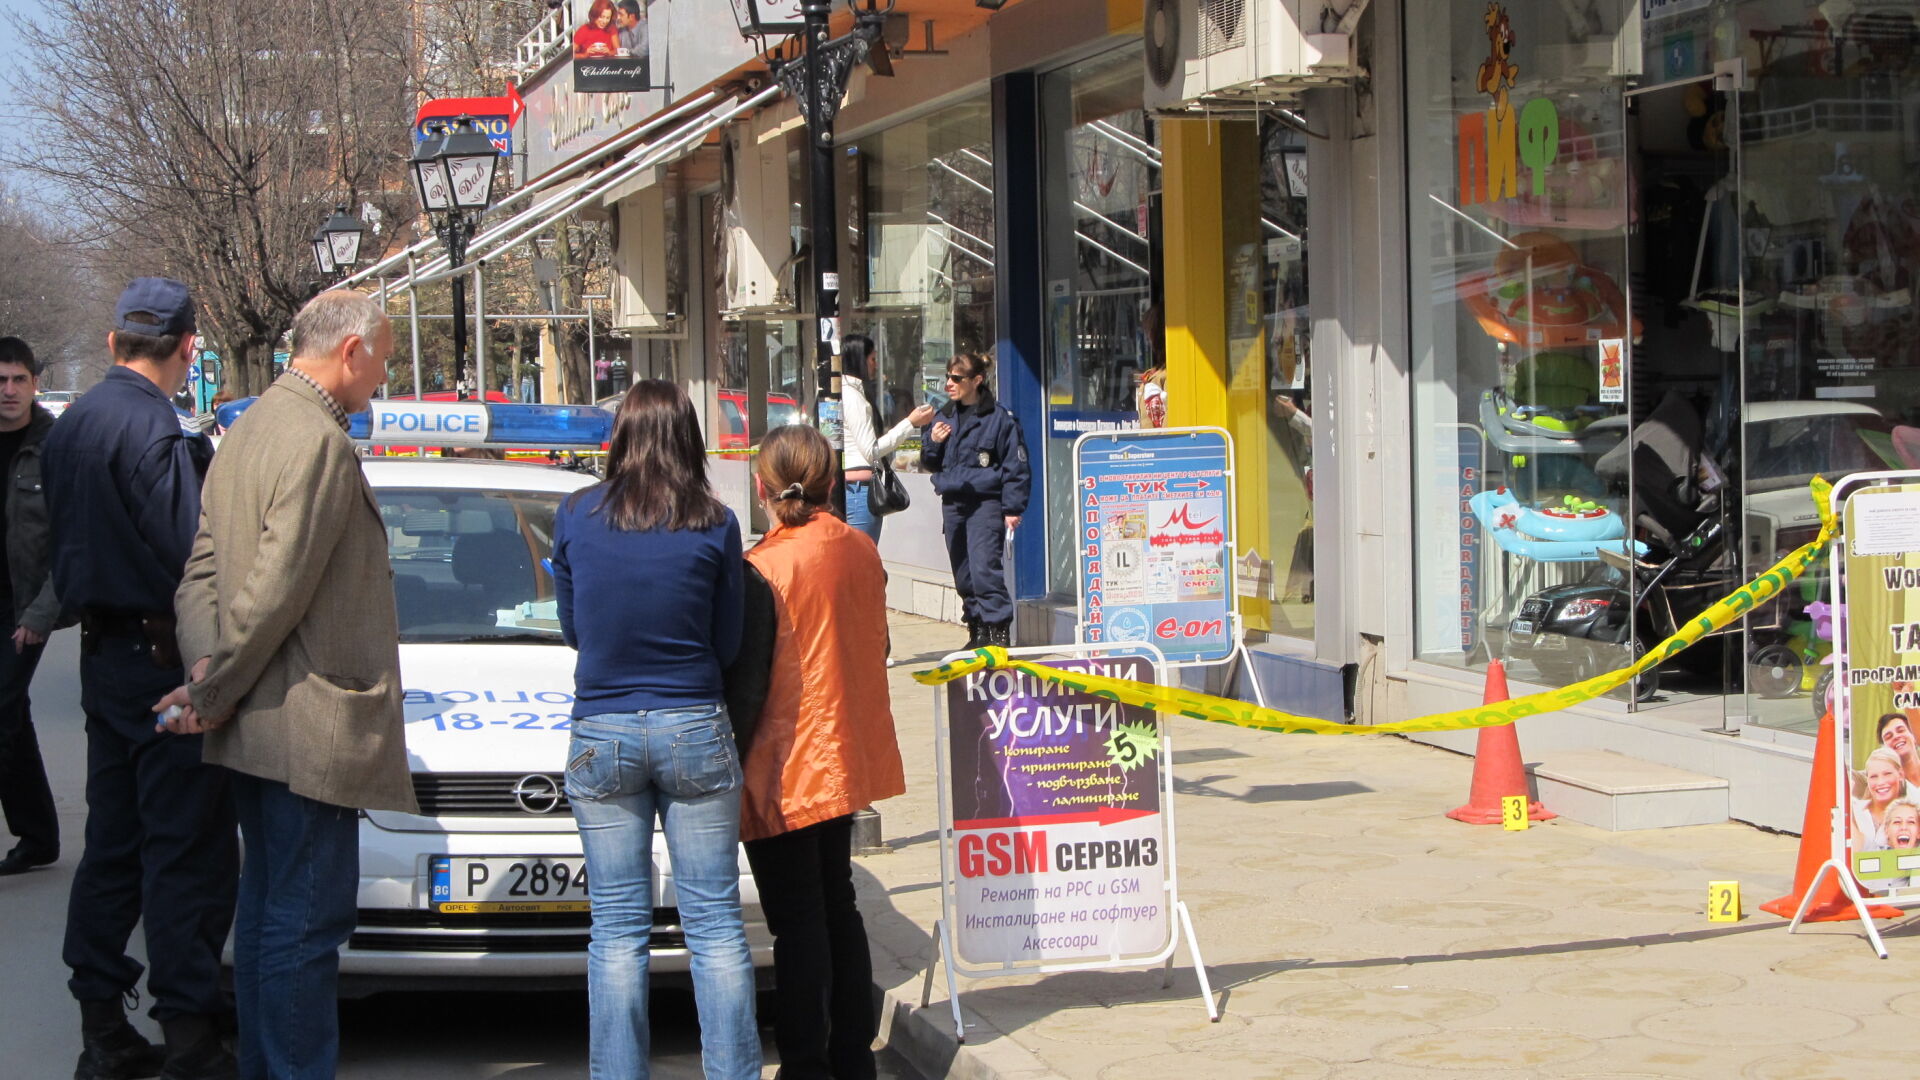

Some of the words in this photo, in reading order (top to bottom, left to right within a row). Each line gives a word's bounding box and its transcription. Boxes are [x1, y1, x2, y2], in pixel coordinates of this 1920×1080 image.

[581, 66, 622, 77] Chillout
[422, 118, 508, 136] CANO
[1459, 97, 1559, 206] ПИФ
[381, 412, 480, 433] POLICE
[1124, 480, 1167, 493] ТУК
[1181, 567, 1220, 576] такса
[1184, 579, 1216, 588] смет
[988, 702, 1118, 740] УСЛУГИ
[1003, 743, 1070, 757] копиране
[1114, 732, 1137, 762] 5
[1020, 759, 1112, 774] принтиране
[1036, 774, 1121, 790] подвързване
[1052, 792, 1140, 808] ламиниране
[1512, 799, 1522, 821] 3
[958, 830, 1048, 878] GSM
[1055, 837, 1159, 872] СЕРВИЗ
[467, 863, 489, 896] P
[508, 862, 588, 896] 2894
[435, 886, 449, 895] BG
[980, 886, 1040, 904] Ремонт
[1044, 885, 1062, 899] на
[1098, 884, 1106, 896] и
[1110, 878, 1140, 896] GSM
[445, 904, 469, 912] OPEL
[1721, 889, 1732, 916] 2
[965, 910, 1066, 929] Инсталиране
[1071, 909, 1088, 923] на
[1092, 902, 1158, 927] софтуер
[1022, 933, 1098, 951] Аксесоари
